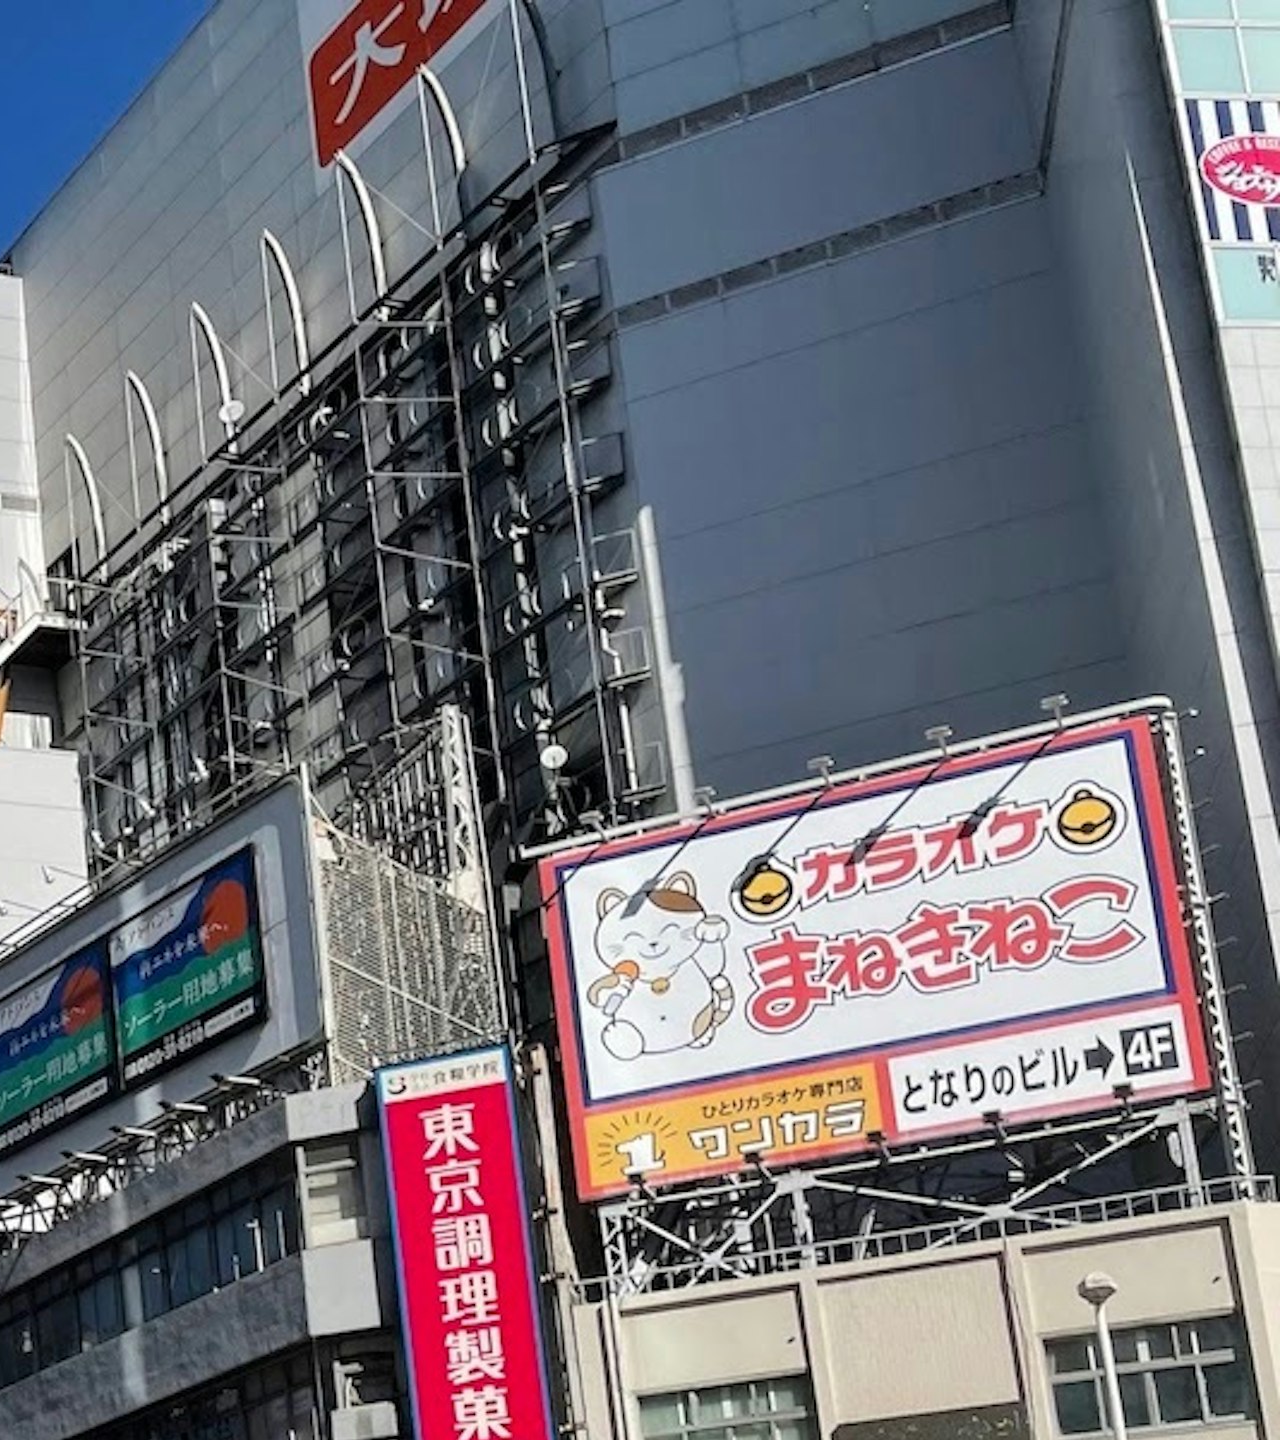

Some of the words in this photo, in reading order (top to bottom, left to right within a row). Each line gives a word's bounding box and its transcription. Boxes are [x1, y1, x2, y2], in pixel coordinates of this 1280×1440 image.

[799, 806, 1047, 899] カラオケ
[124, 948, 254, 1038] ソーラー用地募集
[749, 880, 1140, 1030] まねきねこ
[702, 1076, 864, 1120] ひとりカラオケ専門店
[902, 1047, 1079, 1114] となりのビル
[1126, 1027, 1172, 1070] 4F
[689, 1100, 866, 1160] ワンカラ
